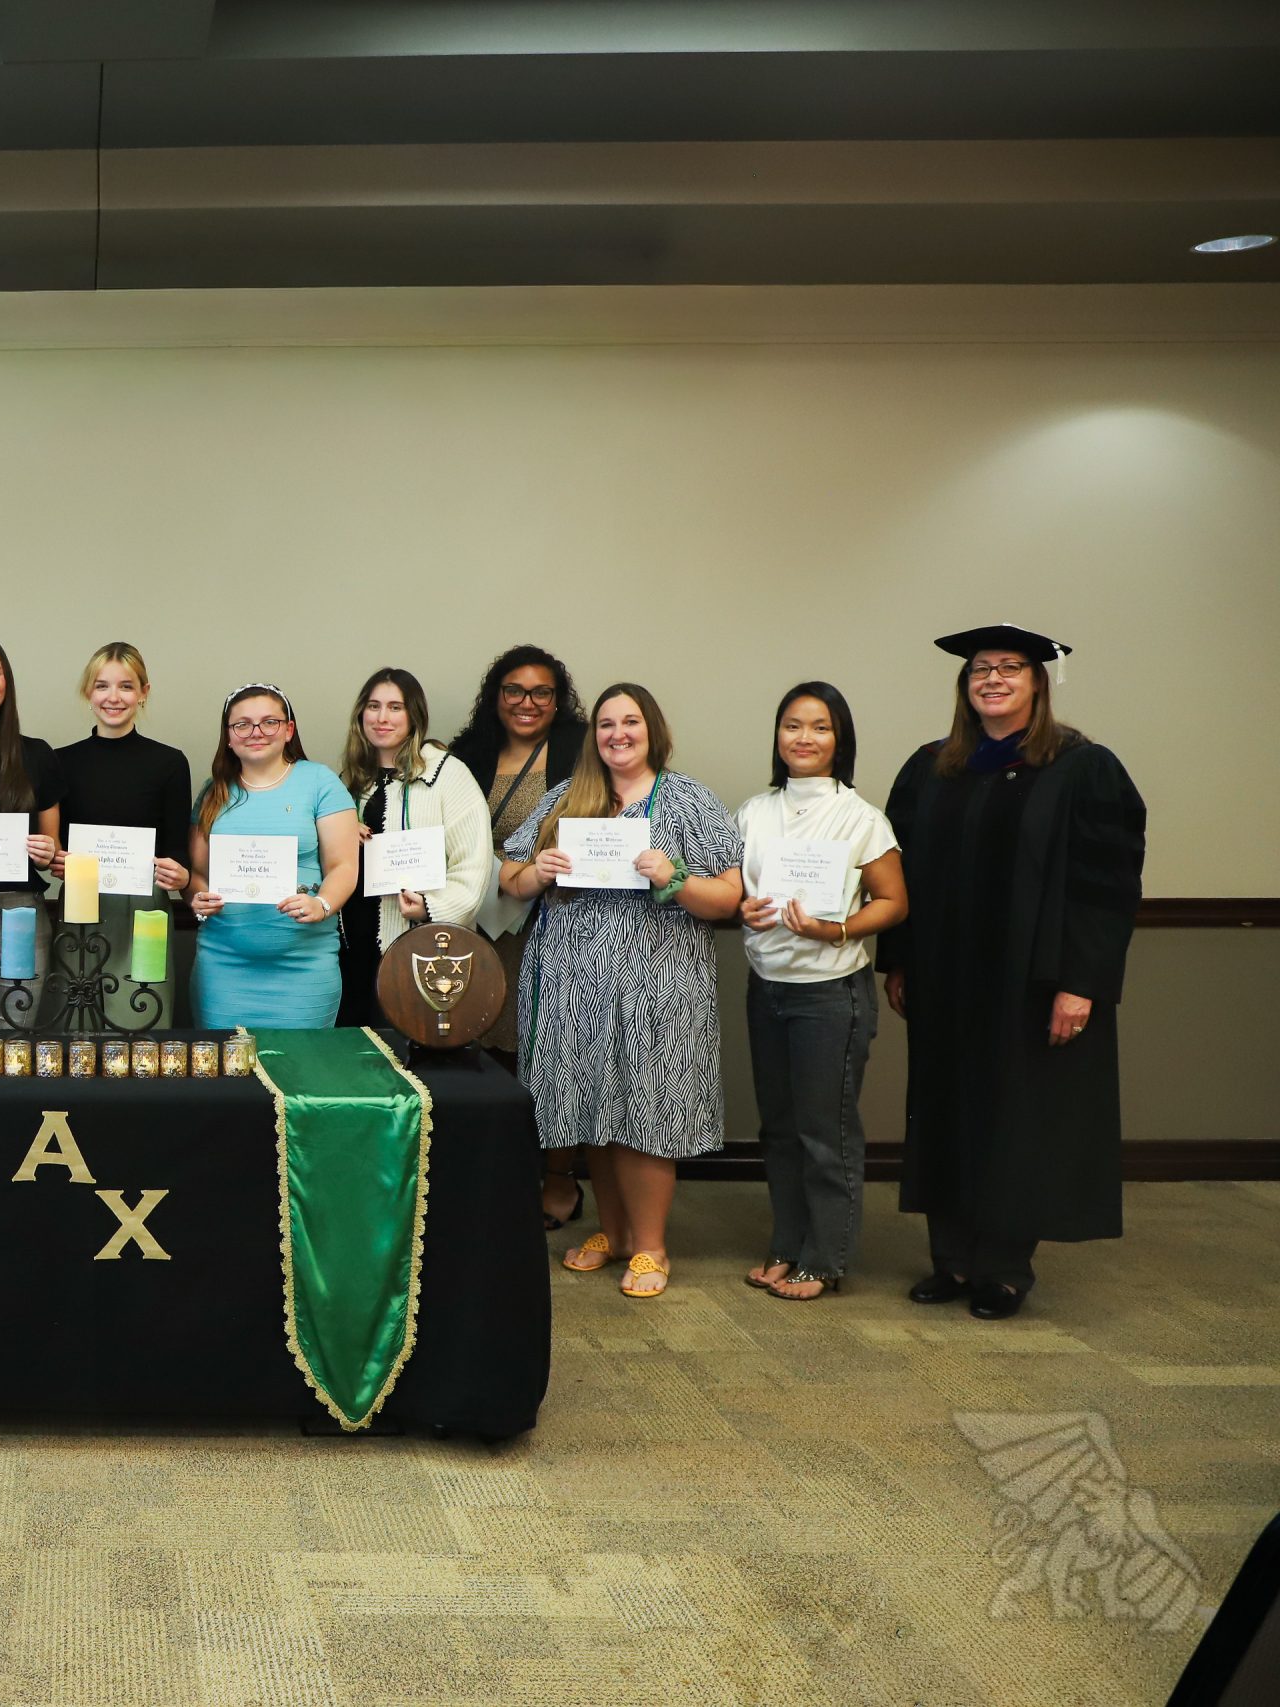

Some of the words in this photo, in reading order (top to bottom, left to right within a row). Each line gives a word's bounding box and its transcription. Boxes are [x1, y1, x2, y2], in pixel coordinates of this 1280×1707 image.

[588, 849, 608, 857] Alpha
[390, 860, 408, 868] Alpha
[238, 865, 257, 873] Alpha
[788, 869, 807, 878] Alpha
[808, 870, 820, 878] Chi
[12, 1110, 97, 1184] A
[94, 1189, 171, 1261] X
